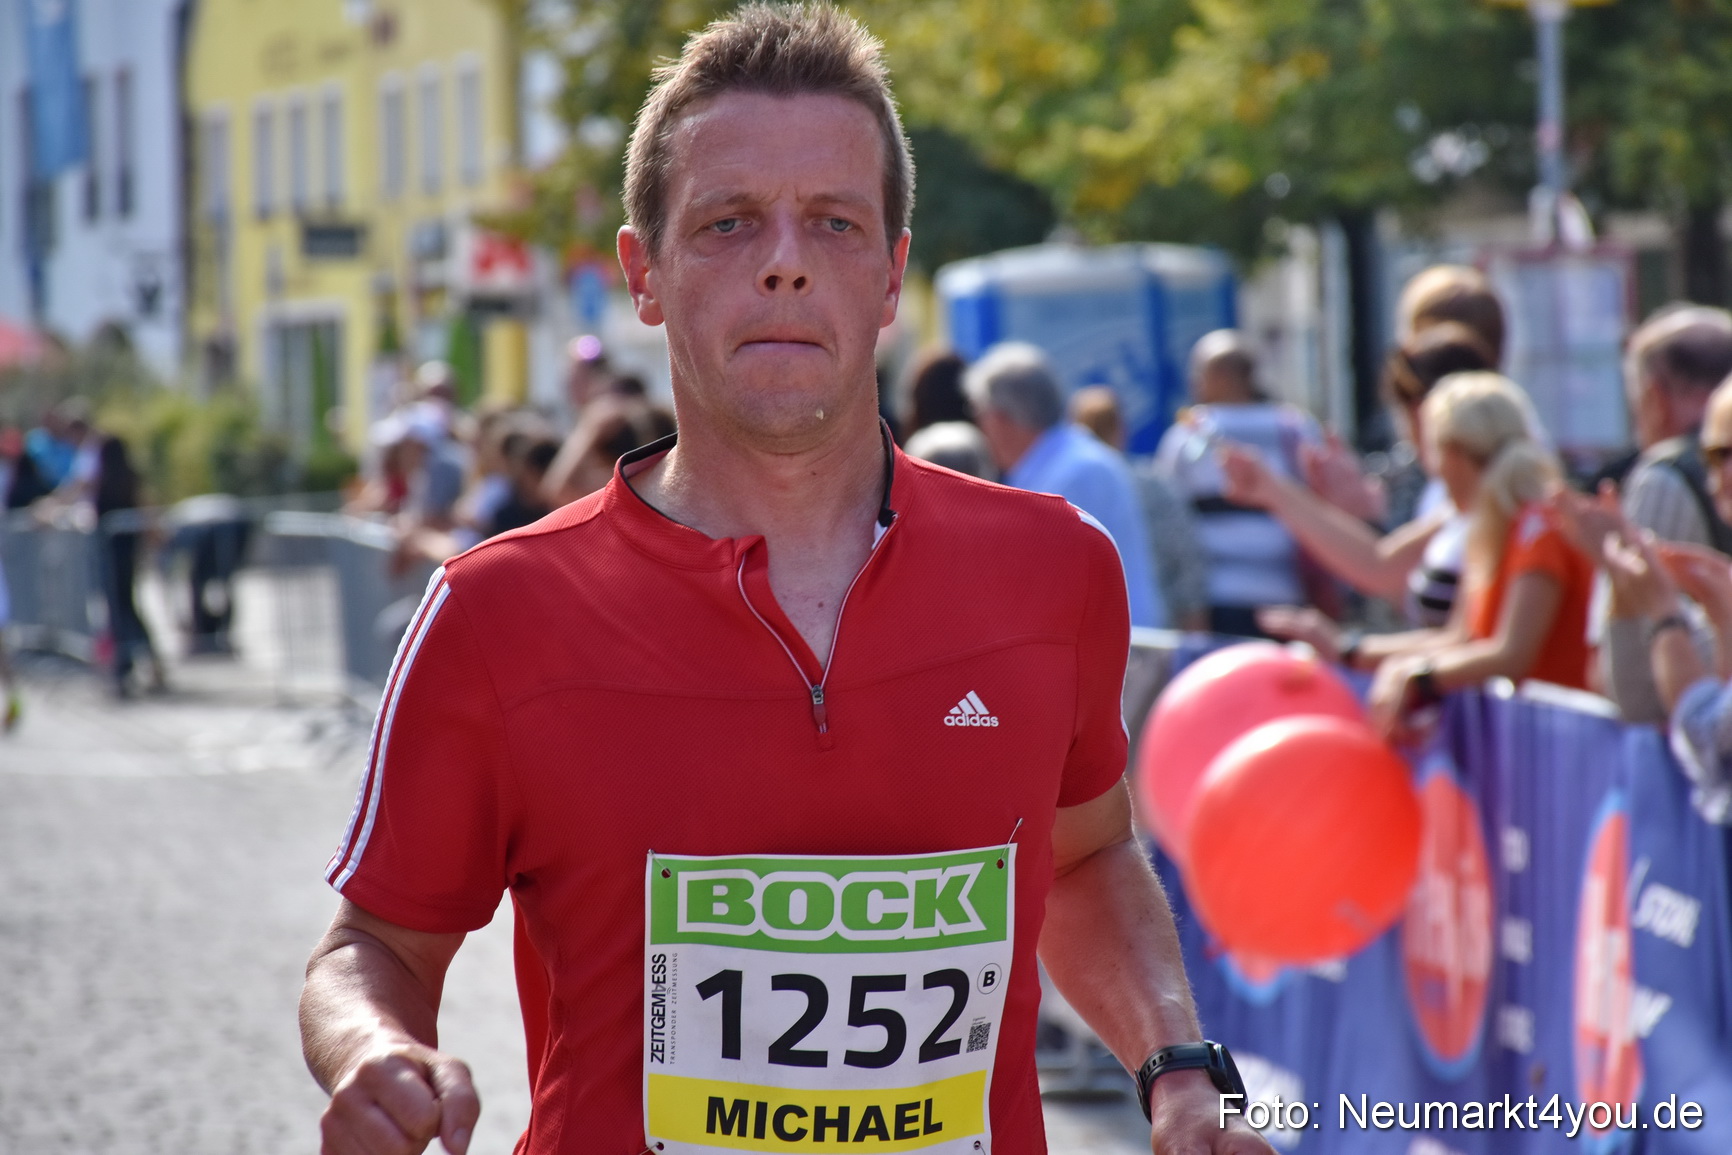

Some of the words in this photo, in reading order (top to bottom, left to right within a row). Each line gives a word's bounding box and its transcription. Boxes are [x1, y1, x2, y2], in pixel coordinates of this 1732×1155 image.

[943, 713, 999, 727] adidas
[679, 865, 985, 940] BOCK
[982, 970, 996, 988] B
[695, 968, 970, 1069] 1252
[706, 1095, 943, 1143] MICHAEL
